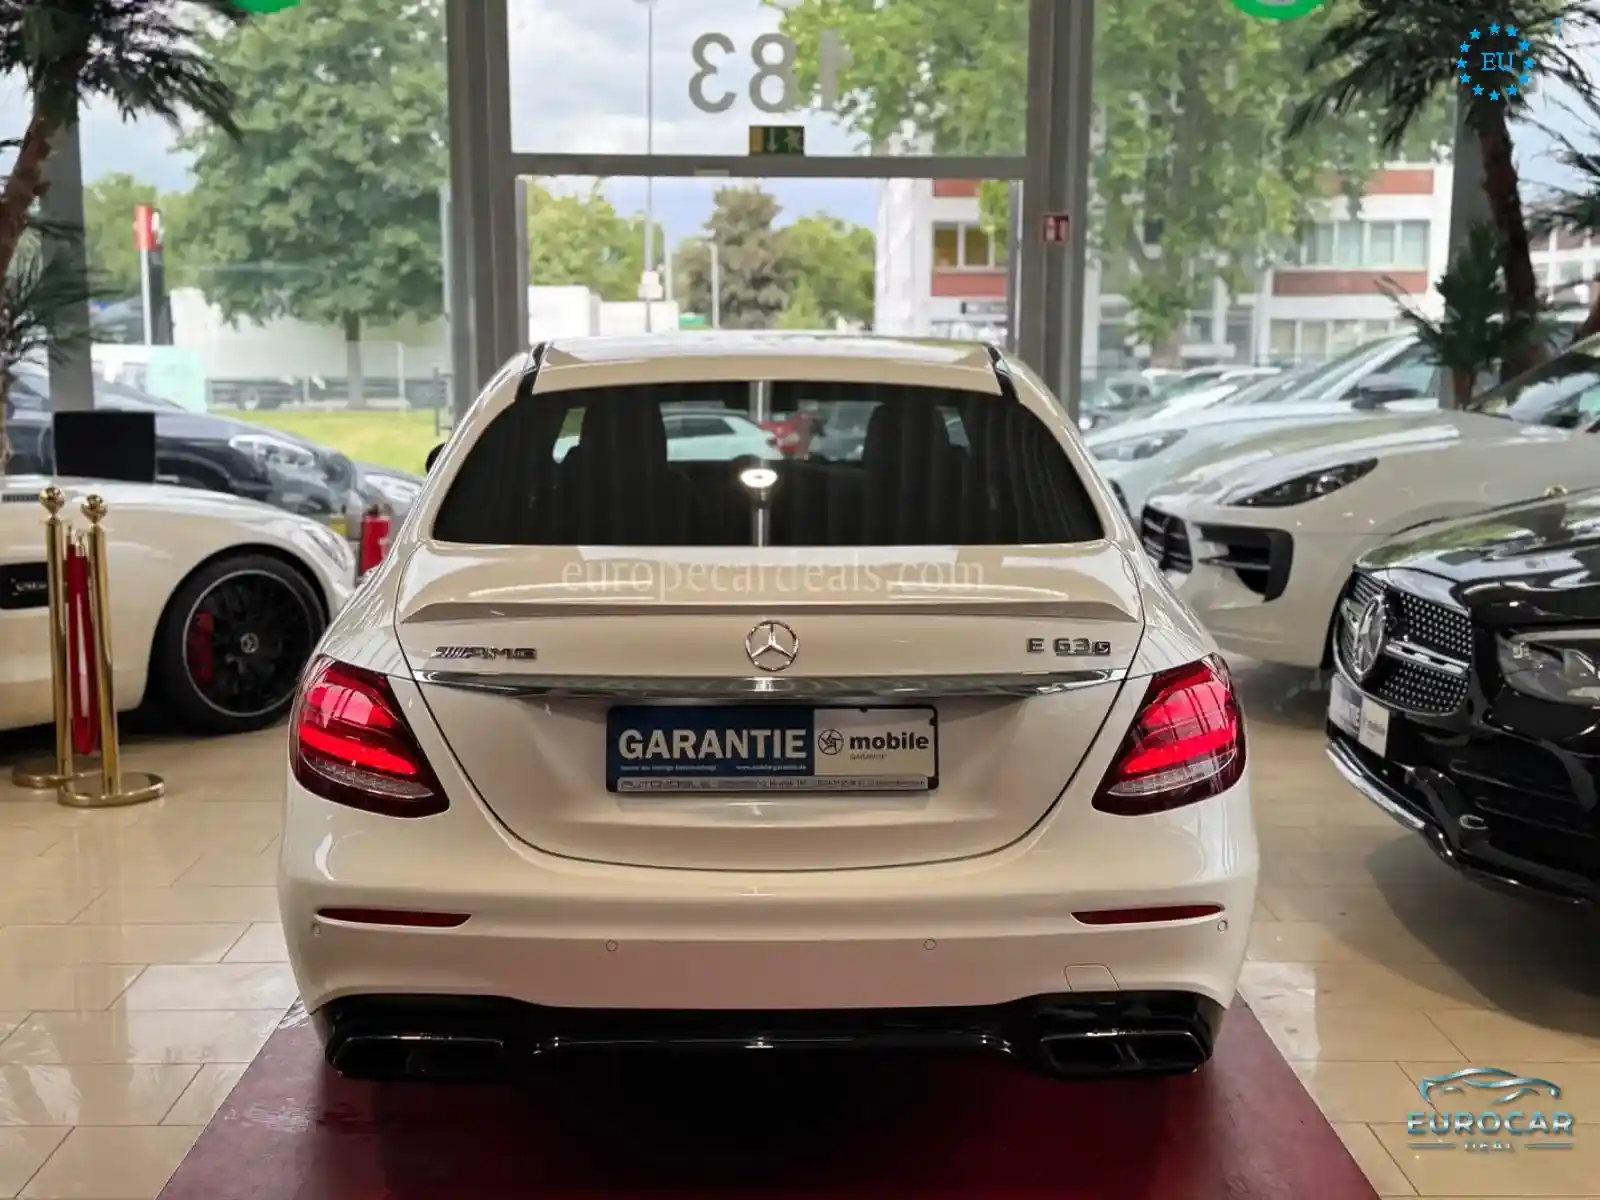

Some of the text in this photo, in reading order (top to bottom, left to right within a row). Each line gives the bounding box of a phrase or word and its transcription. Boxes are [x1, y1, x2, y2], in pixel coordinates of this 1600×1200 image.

[1026, 637, 1045, 653] E
[618, 729, 807, 760] GARANTIE
[849, 732, 929, 750] mobile
